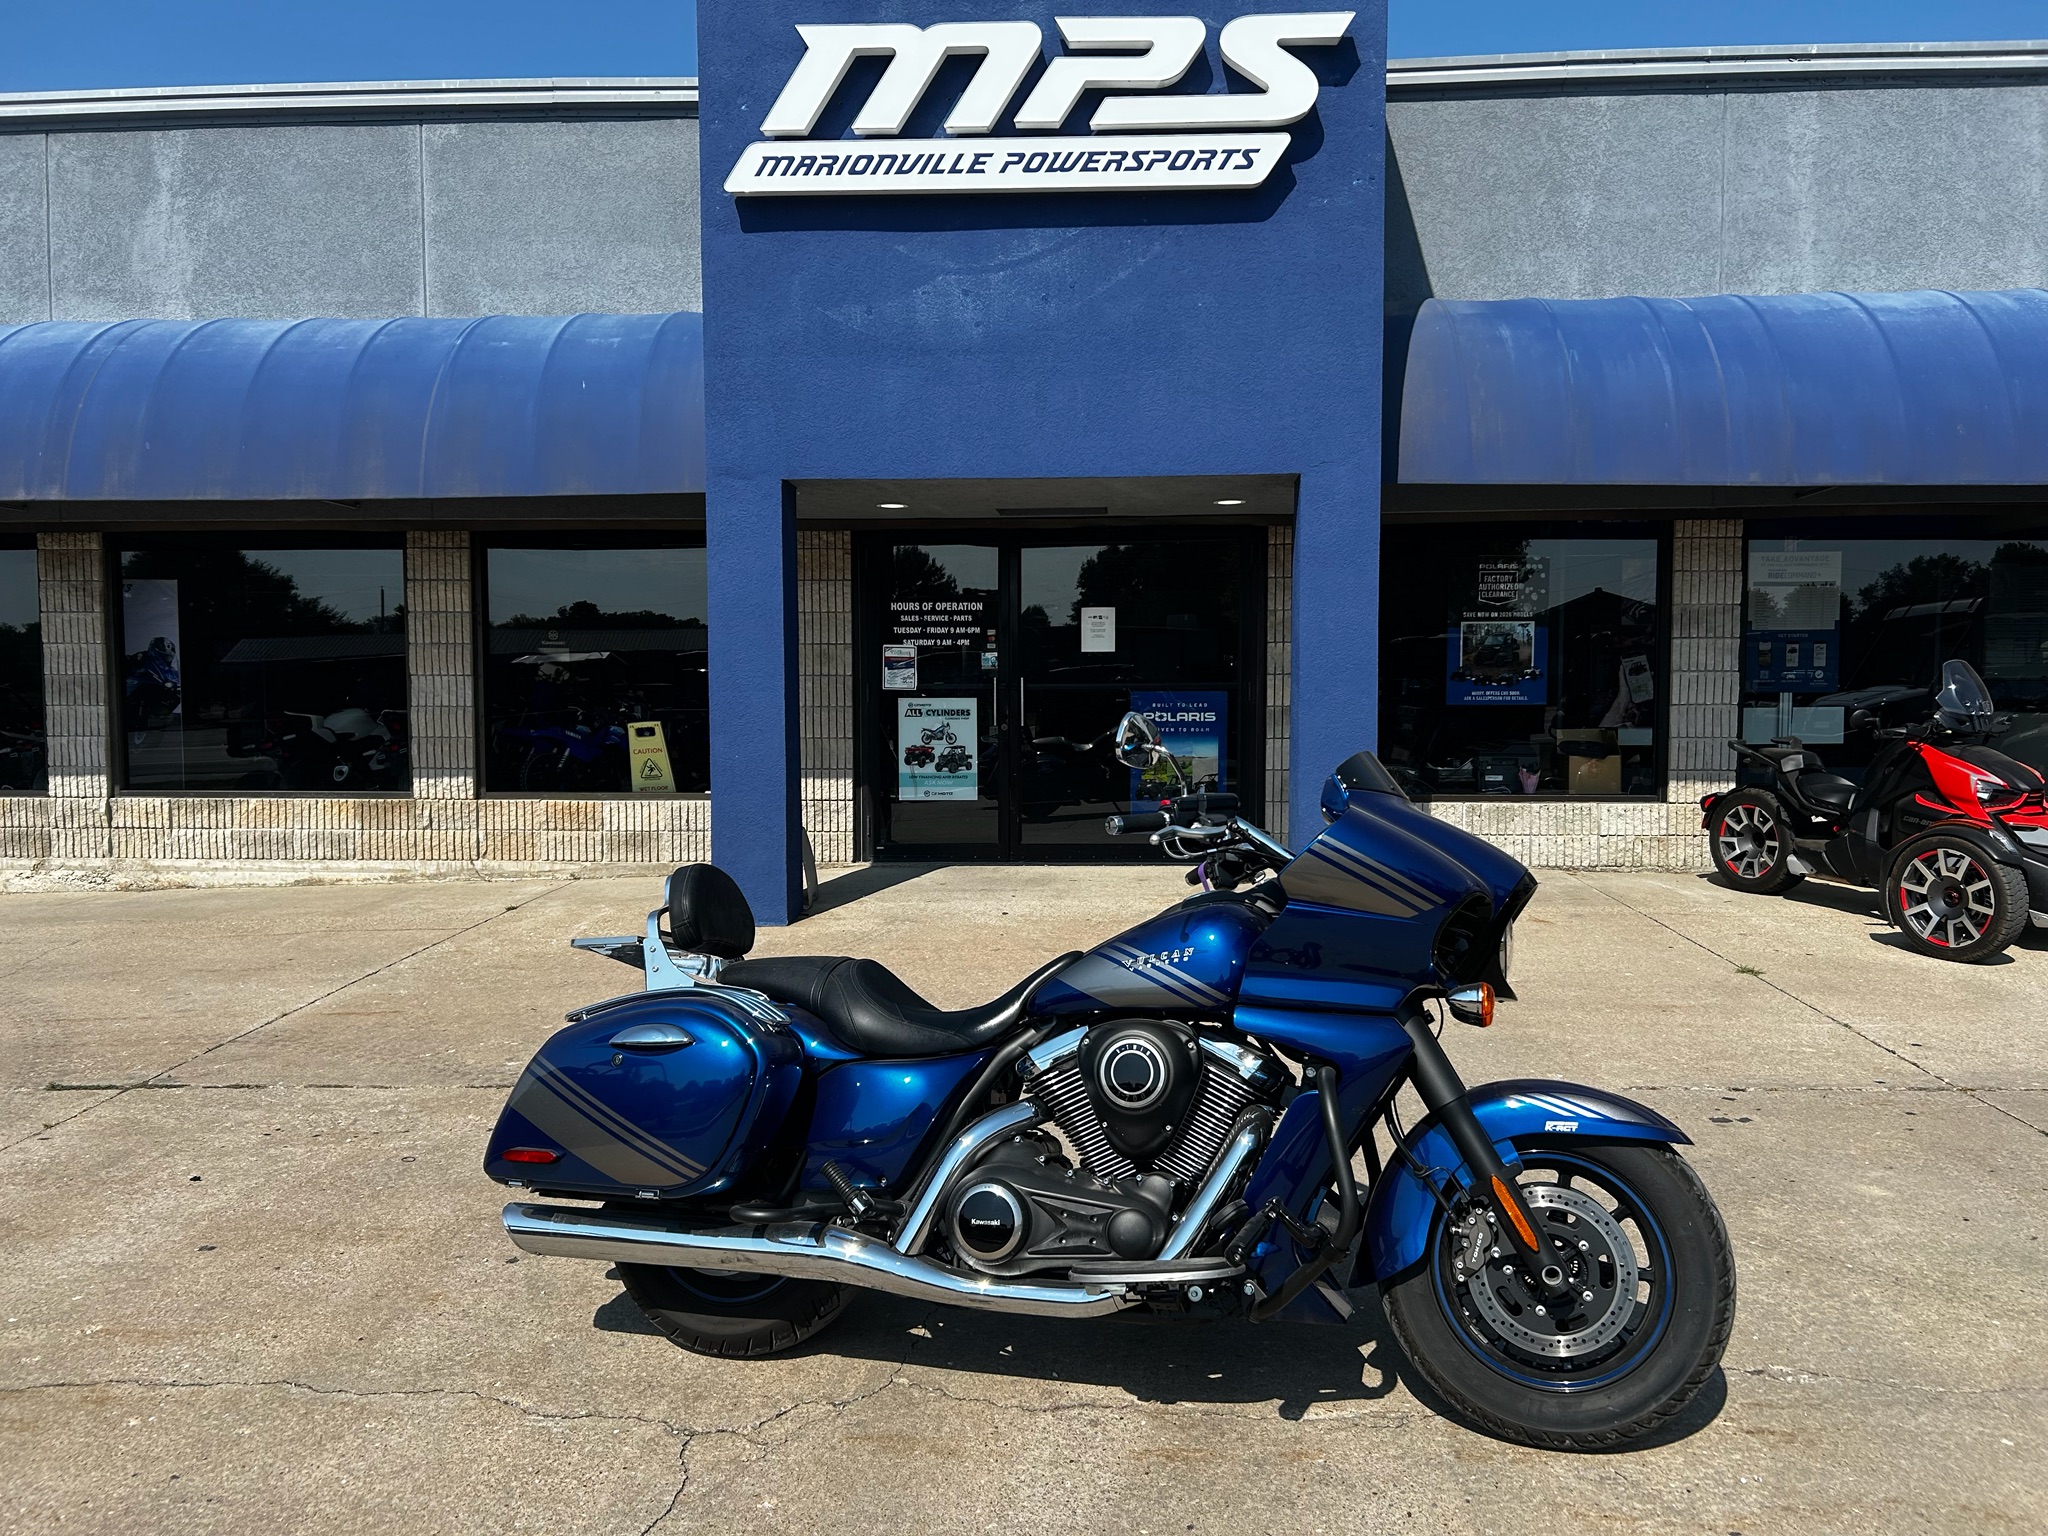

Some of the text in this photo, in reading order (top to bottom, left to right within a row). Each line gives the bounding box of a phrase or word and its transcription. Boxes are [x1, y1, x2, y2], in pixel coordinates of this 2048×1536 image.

[760, 10, 1356, 136] MPS
[754, 147, 1262, 178] MARIONVILLE POWERSPORTS
[890, 602, 983, 611] HOURS OF OPERATION
[905, 709, 971, 717] ALL CYLINDERS
[1143, 711, 1217, 722] POLARIS
[632, 747, 663, 755] CAUTION
[1121, 947, 1195, 968] VULCAN
[1544, 1123, 1579, 1132] K-ACT
[970, 1218, 1001, 1226] Kawasaki
[1471, 1232, 1484, 1263] TOKICO
